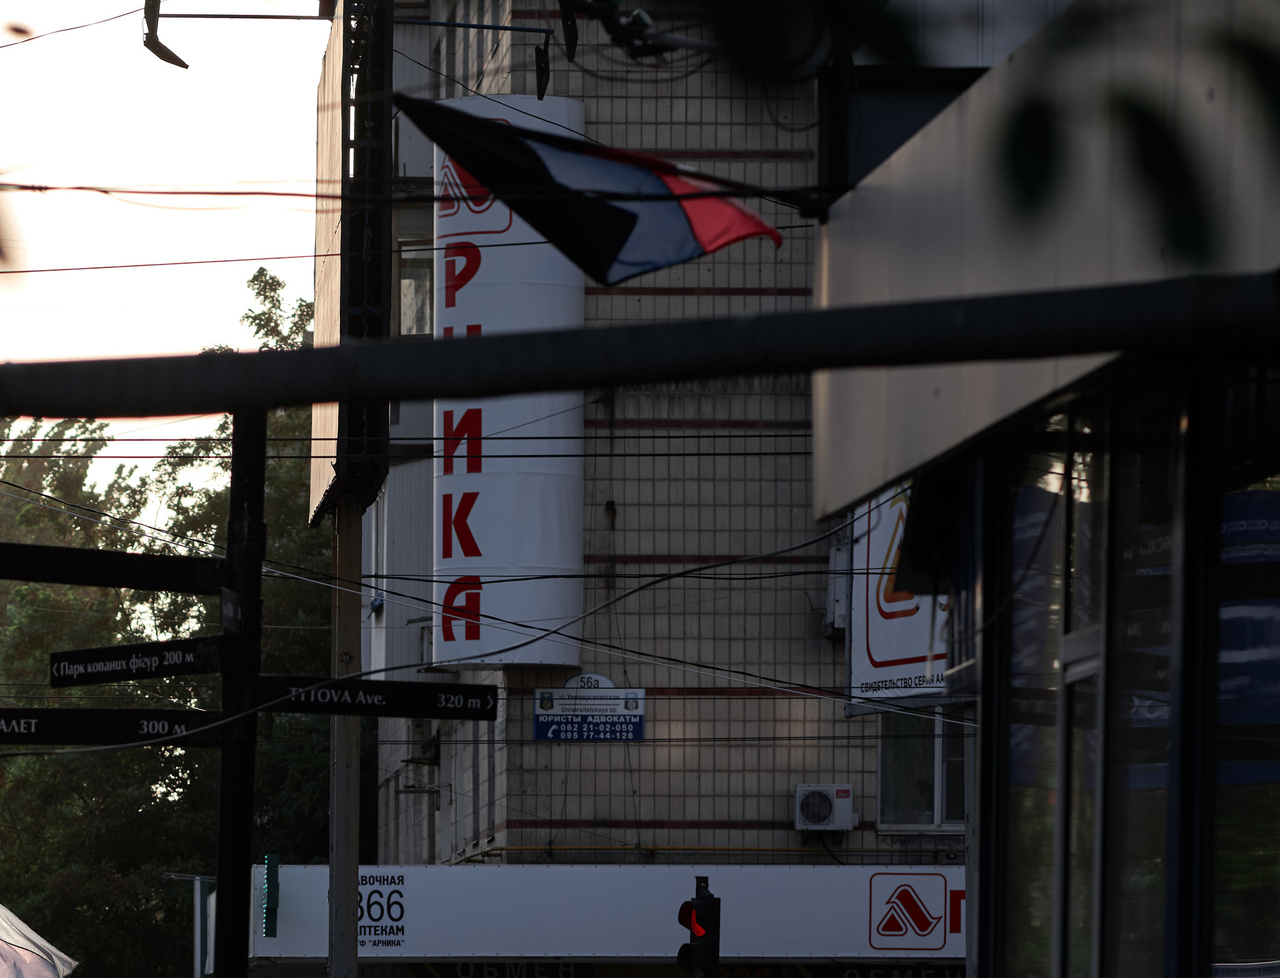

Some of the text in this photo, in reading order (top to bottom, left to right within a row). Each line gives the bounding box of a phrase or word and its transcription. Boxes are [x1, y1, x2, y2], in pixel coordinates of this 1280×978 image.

[60, 651, 194, 679] Парк кованих фігур 200 м
[860, 677, 913, 693] СВИДЕТЕЛЬСТВО
[356, 691, 387, 706] Ave.
[437, 694, 464, 708] 320
[467, 698, 481, 709] m
[587, 715, 640, 723] АДВОКАТЫ
[138, 720, 168, 734] 300
[172, 724, 186, 735] м
[358, 875, 404, 886] ВОЧНАЯ
[358, 925, 404, 936] ПТЕКАМ
[369, 939, 405, 947] "АРНИКА"
